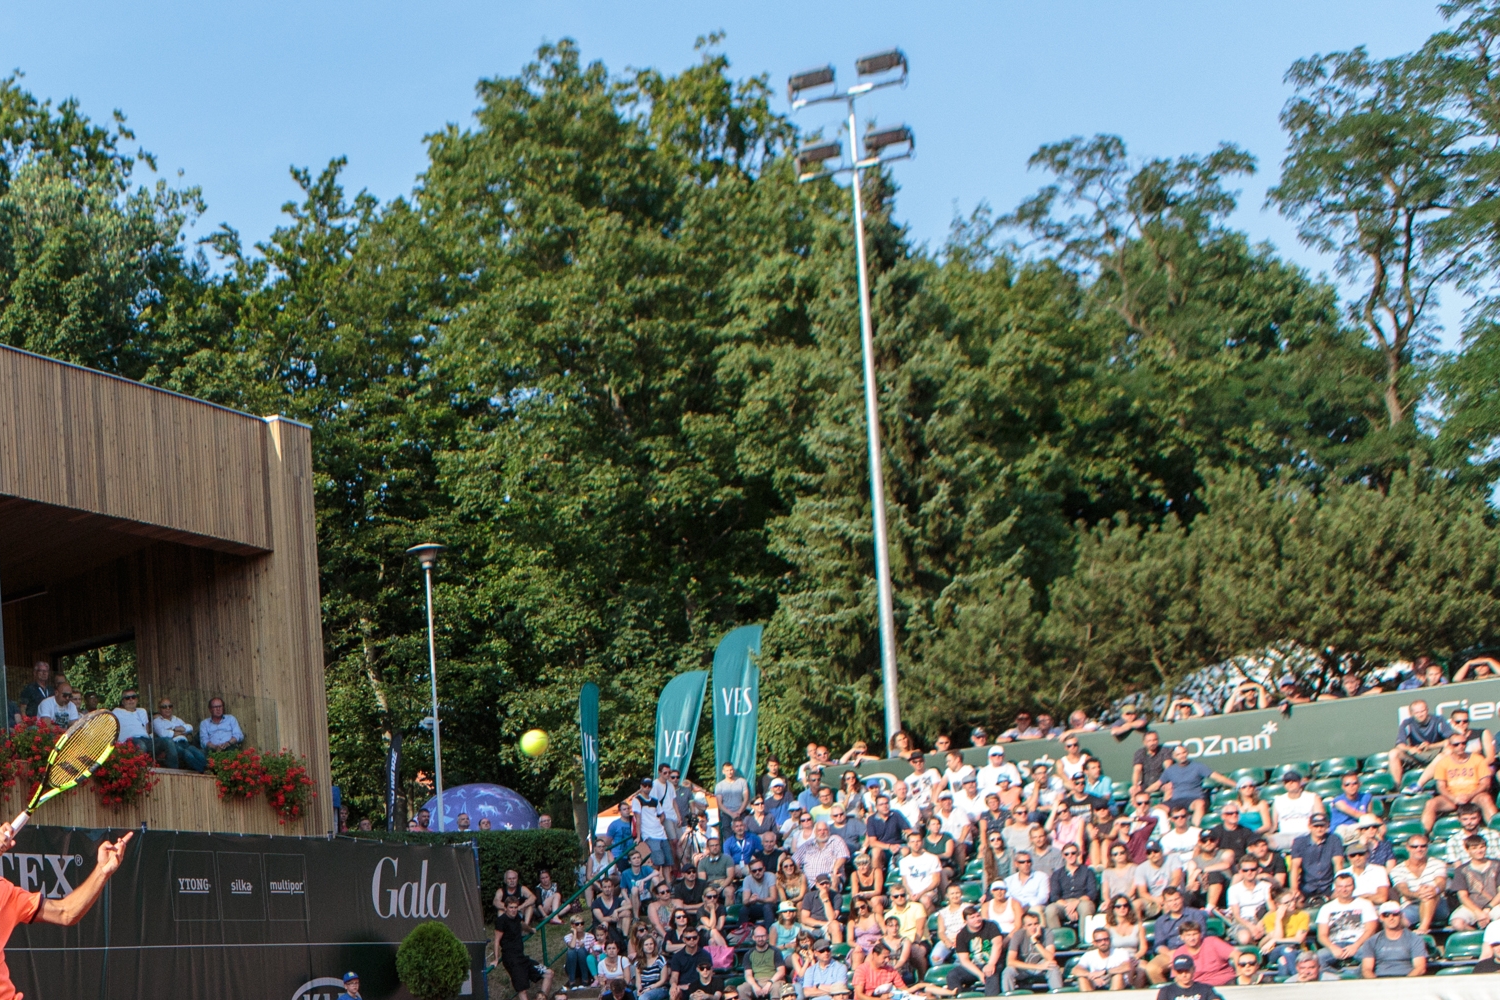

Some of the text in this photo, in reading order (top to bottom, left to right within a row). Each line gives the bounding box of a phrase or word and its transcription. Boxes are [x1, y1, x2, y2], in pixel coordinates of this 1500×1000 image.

[722, 687, 753, 716] YES
[664, 730, 691, 758] YES
[178, 878, 209, 891] YTONG
[230, 879, 252, 892] silka
[269, 879, 304, 895] multipor
[371, 856, 450, 919] Gala
